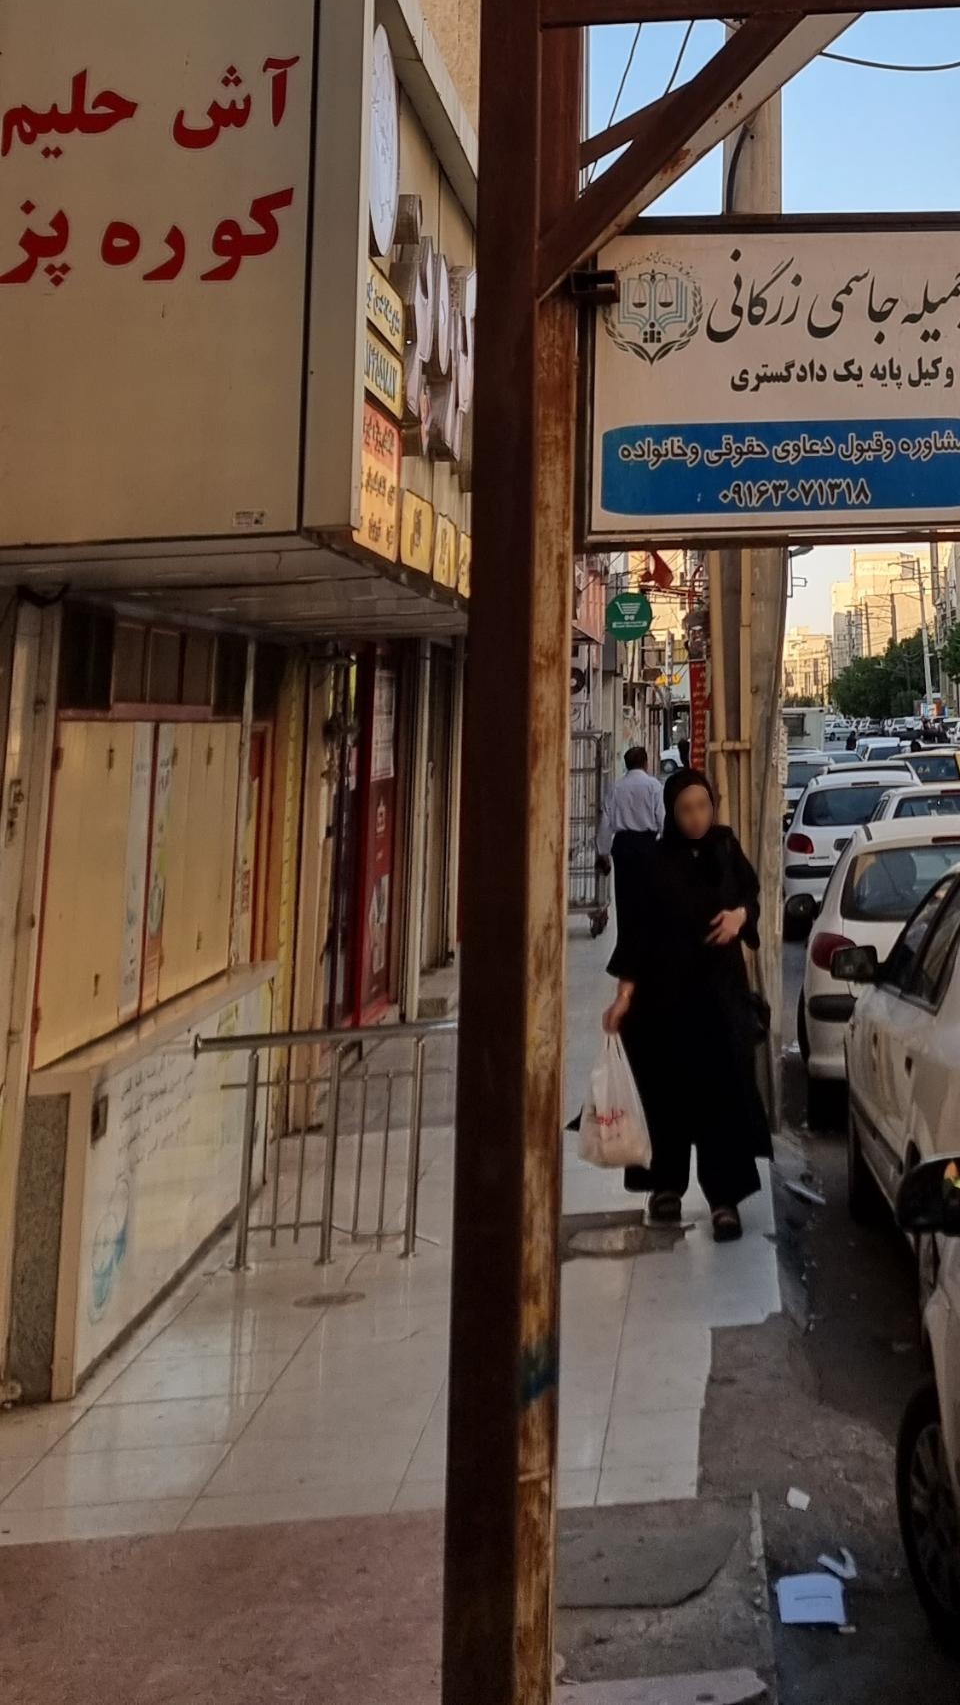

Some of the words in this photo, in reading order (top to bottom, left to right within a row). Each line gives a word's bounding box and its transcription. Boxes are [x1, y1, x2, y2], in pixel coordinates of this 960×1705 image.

[0, 68, 138, 159] حلیم
[172, 55, 300, 150] آش
[101, 187, 294, 281] کوره
[705, 247, 803, 344] زرگانی
[806, 267, 900, 345] جاسمی
[730, 358, 828, 393] دادگستری
[832, 358, 864, 389] یک
[869, 358, 902, 390] پایه
[908, 356, 955, 389] وکیل
[703, 435, 769, 469] حقوقی
[772, 434, 835, 466] دعاوی
[718, 477, 872, 508] ۰۹۱۶۳۰۷۱۳۱۸
